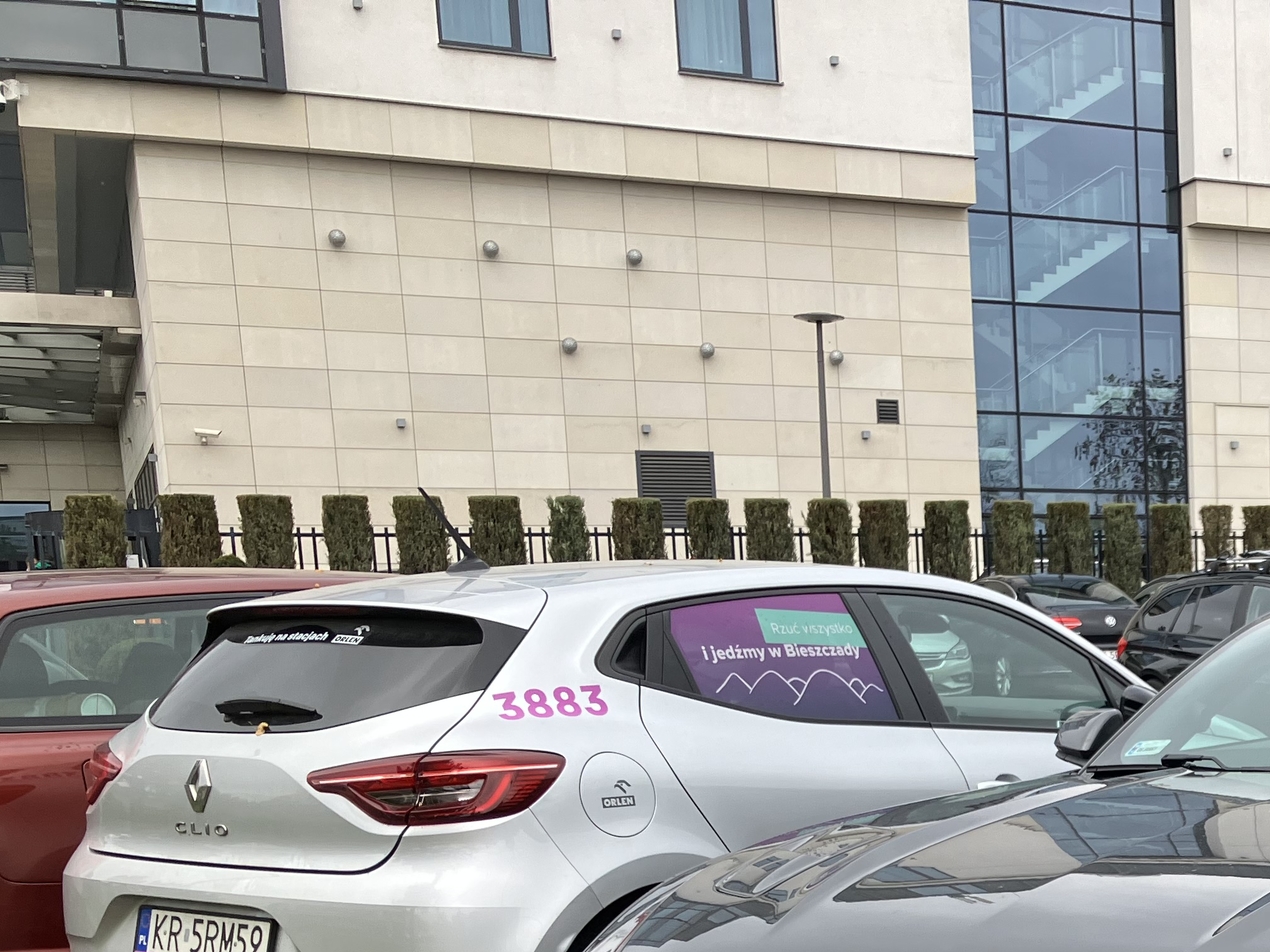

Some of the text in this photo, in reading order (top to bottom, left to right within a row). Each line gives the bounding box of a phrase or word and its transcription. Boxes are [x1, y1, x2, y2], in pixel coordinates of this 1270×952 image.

[275, 633, 287, 642] na
[287, 631, 329, 642] stacjach
[334, 635, 361, 643] ORLEN
[771, 622, 853, 637] Rzuć wszystko
[701, 643, 860, 664] i jedźmy w Bieszczady
[492, 684, 609, 721] 3883
[602, 796, 635, 808] ORLEN
[174, 821, 229, 837] CLIO
[138, 934, 147, 946] PL
[152, 913, 183, 952] KR
